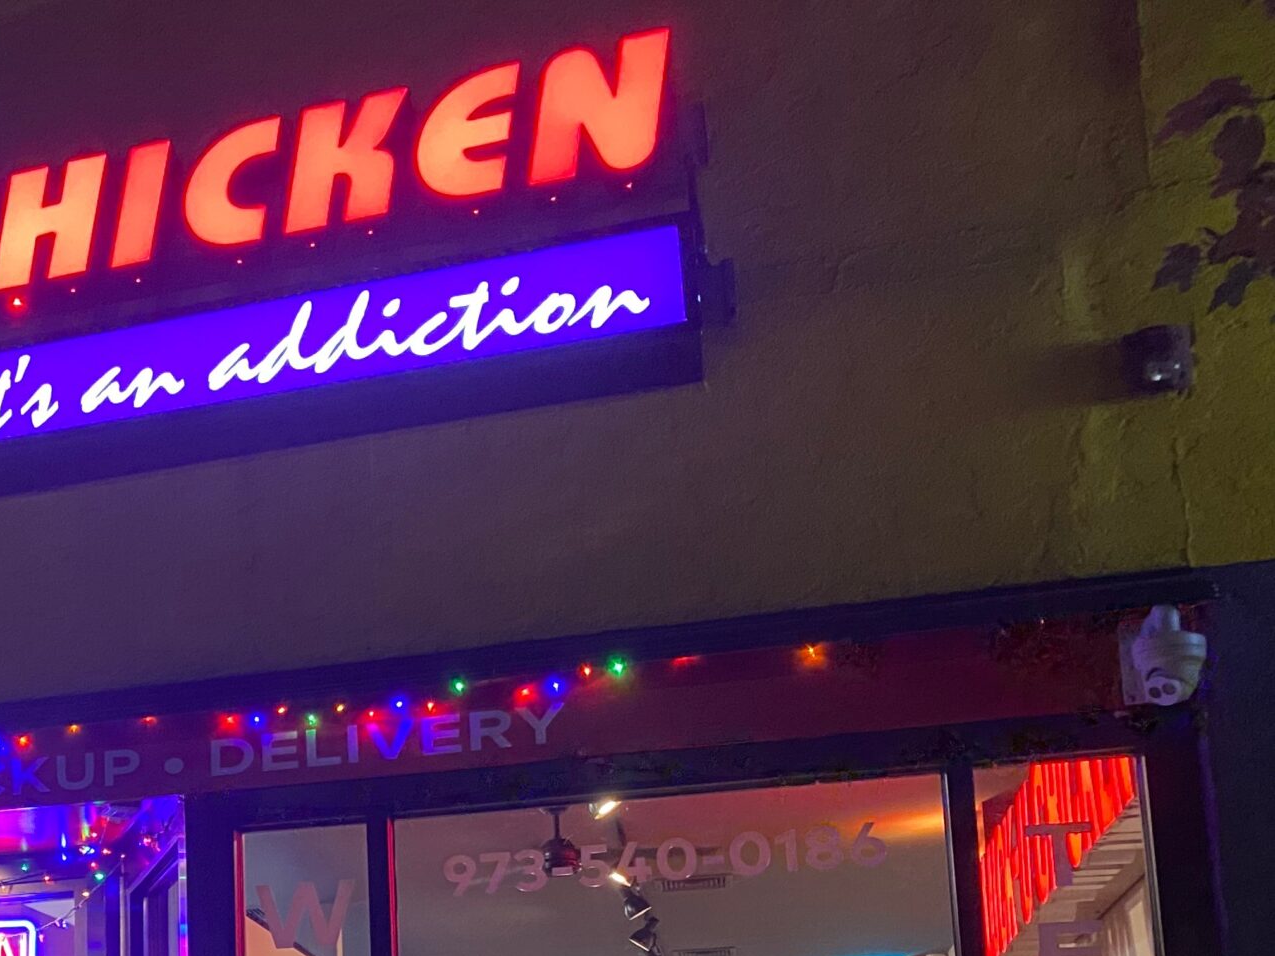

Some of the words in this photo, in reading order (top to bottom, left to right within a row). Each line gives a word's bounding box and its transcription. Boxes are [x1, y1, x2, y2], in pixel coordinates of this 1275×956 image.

[81, 367, 185, 416] an
[208, 276, 651, 393] addiction
[210, 702, 566, 780] DELIVERY
